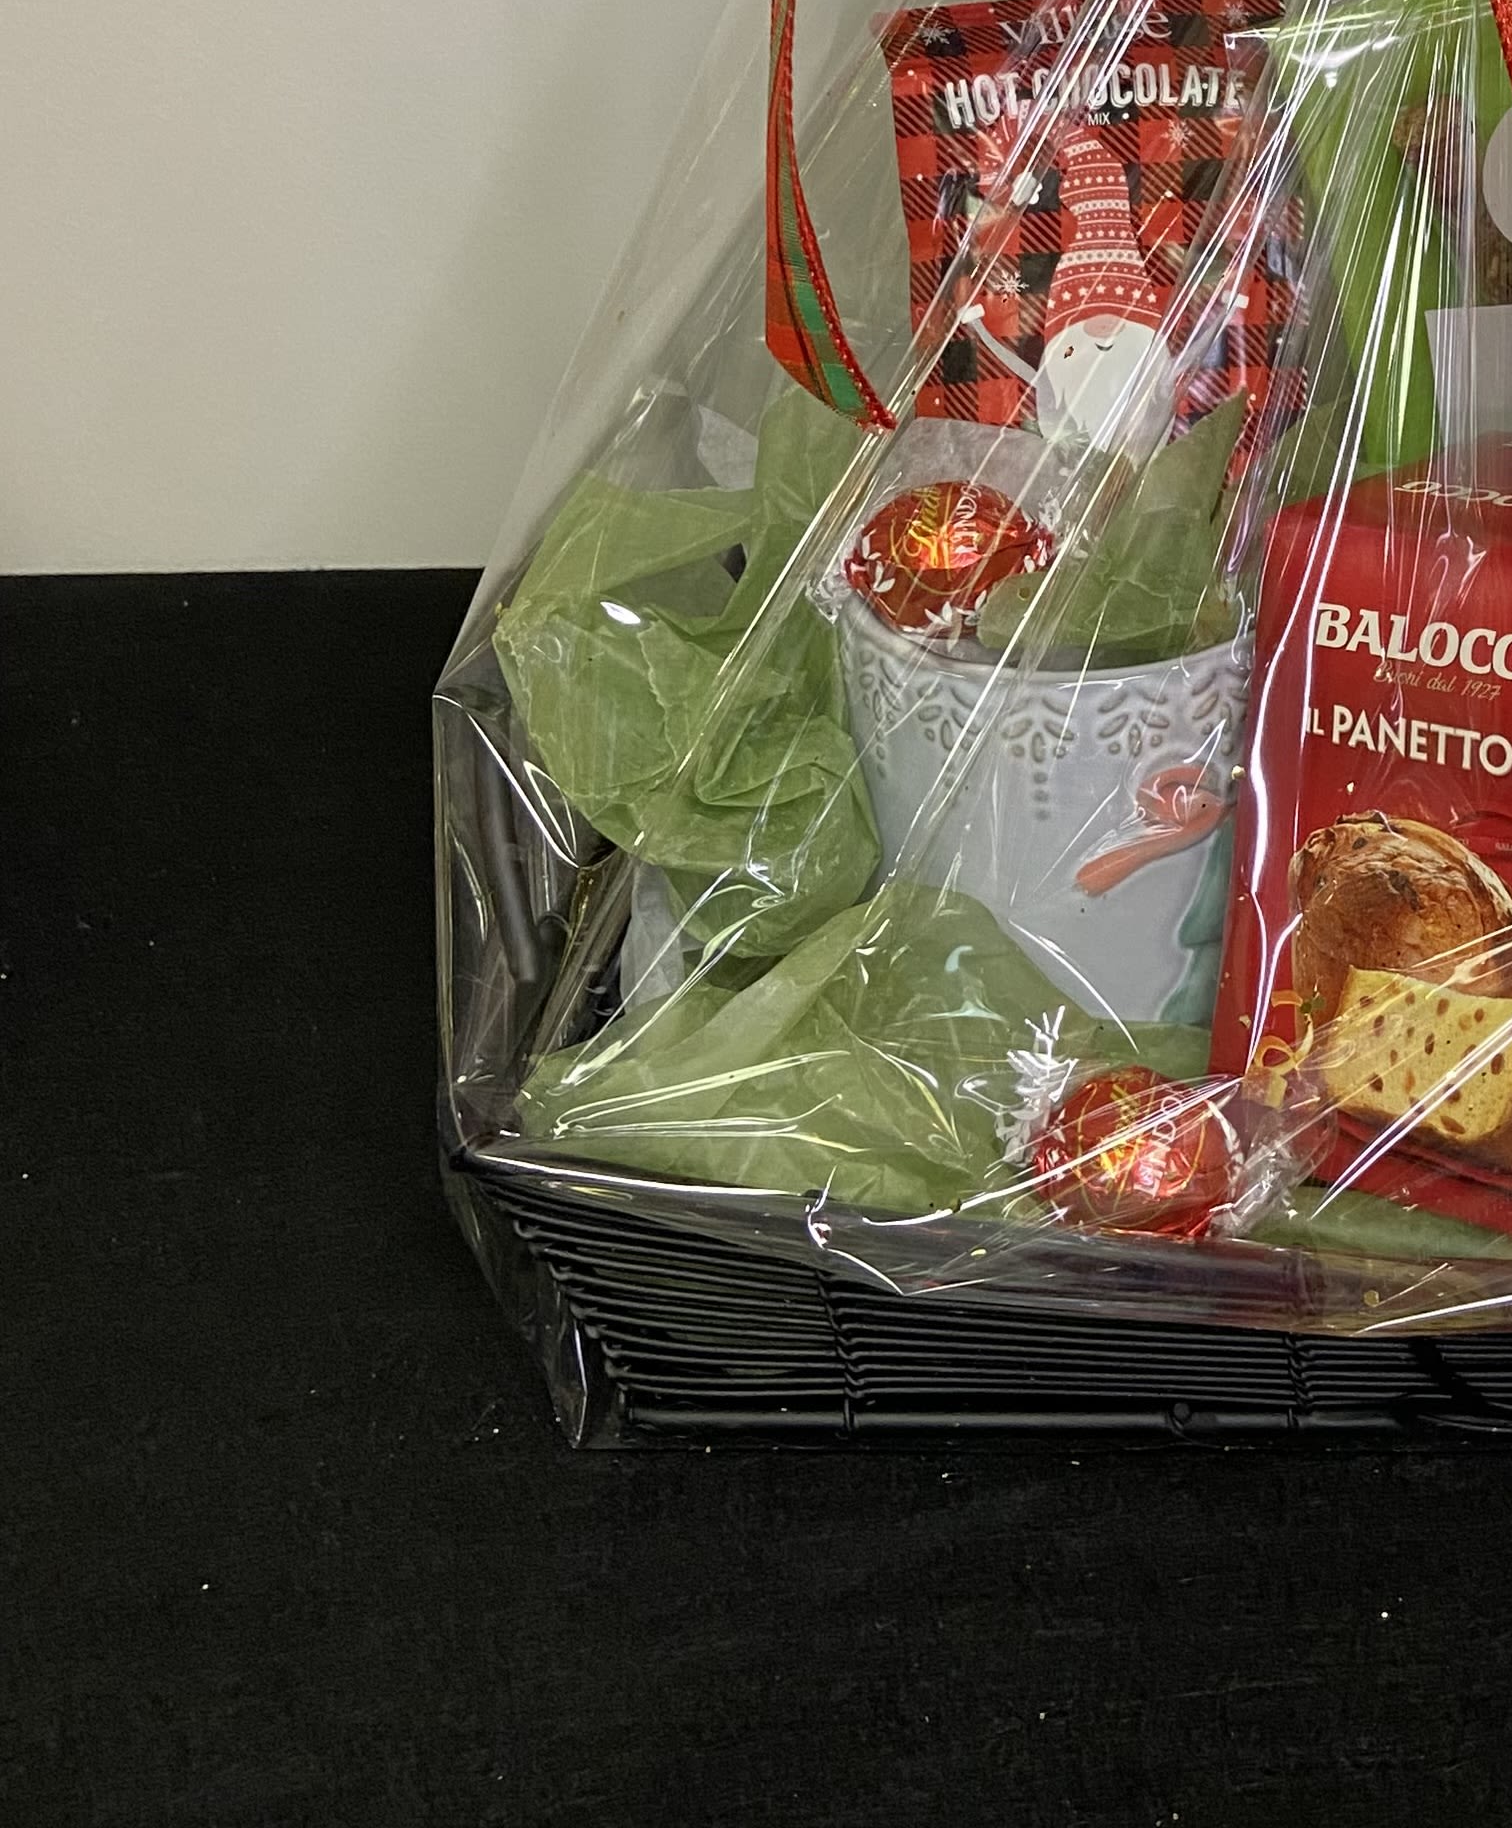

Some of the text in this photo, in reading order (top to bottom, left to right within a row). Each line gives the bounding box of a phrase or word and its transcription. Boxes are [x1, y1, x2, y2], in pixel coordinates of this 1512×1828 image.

[997, 4, 1172, 46] vilae
[945, 63, 1246, 129] HOT CHOCOLATE
[1087, 112, 1110, 126] MIX
[1427, 672, 1455, 693] dal
[1460, 678, 1502, 701] 1927
[1306, 707, 1325, 736] IL
